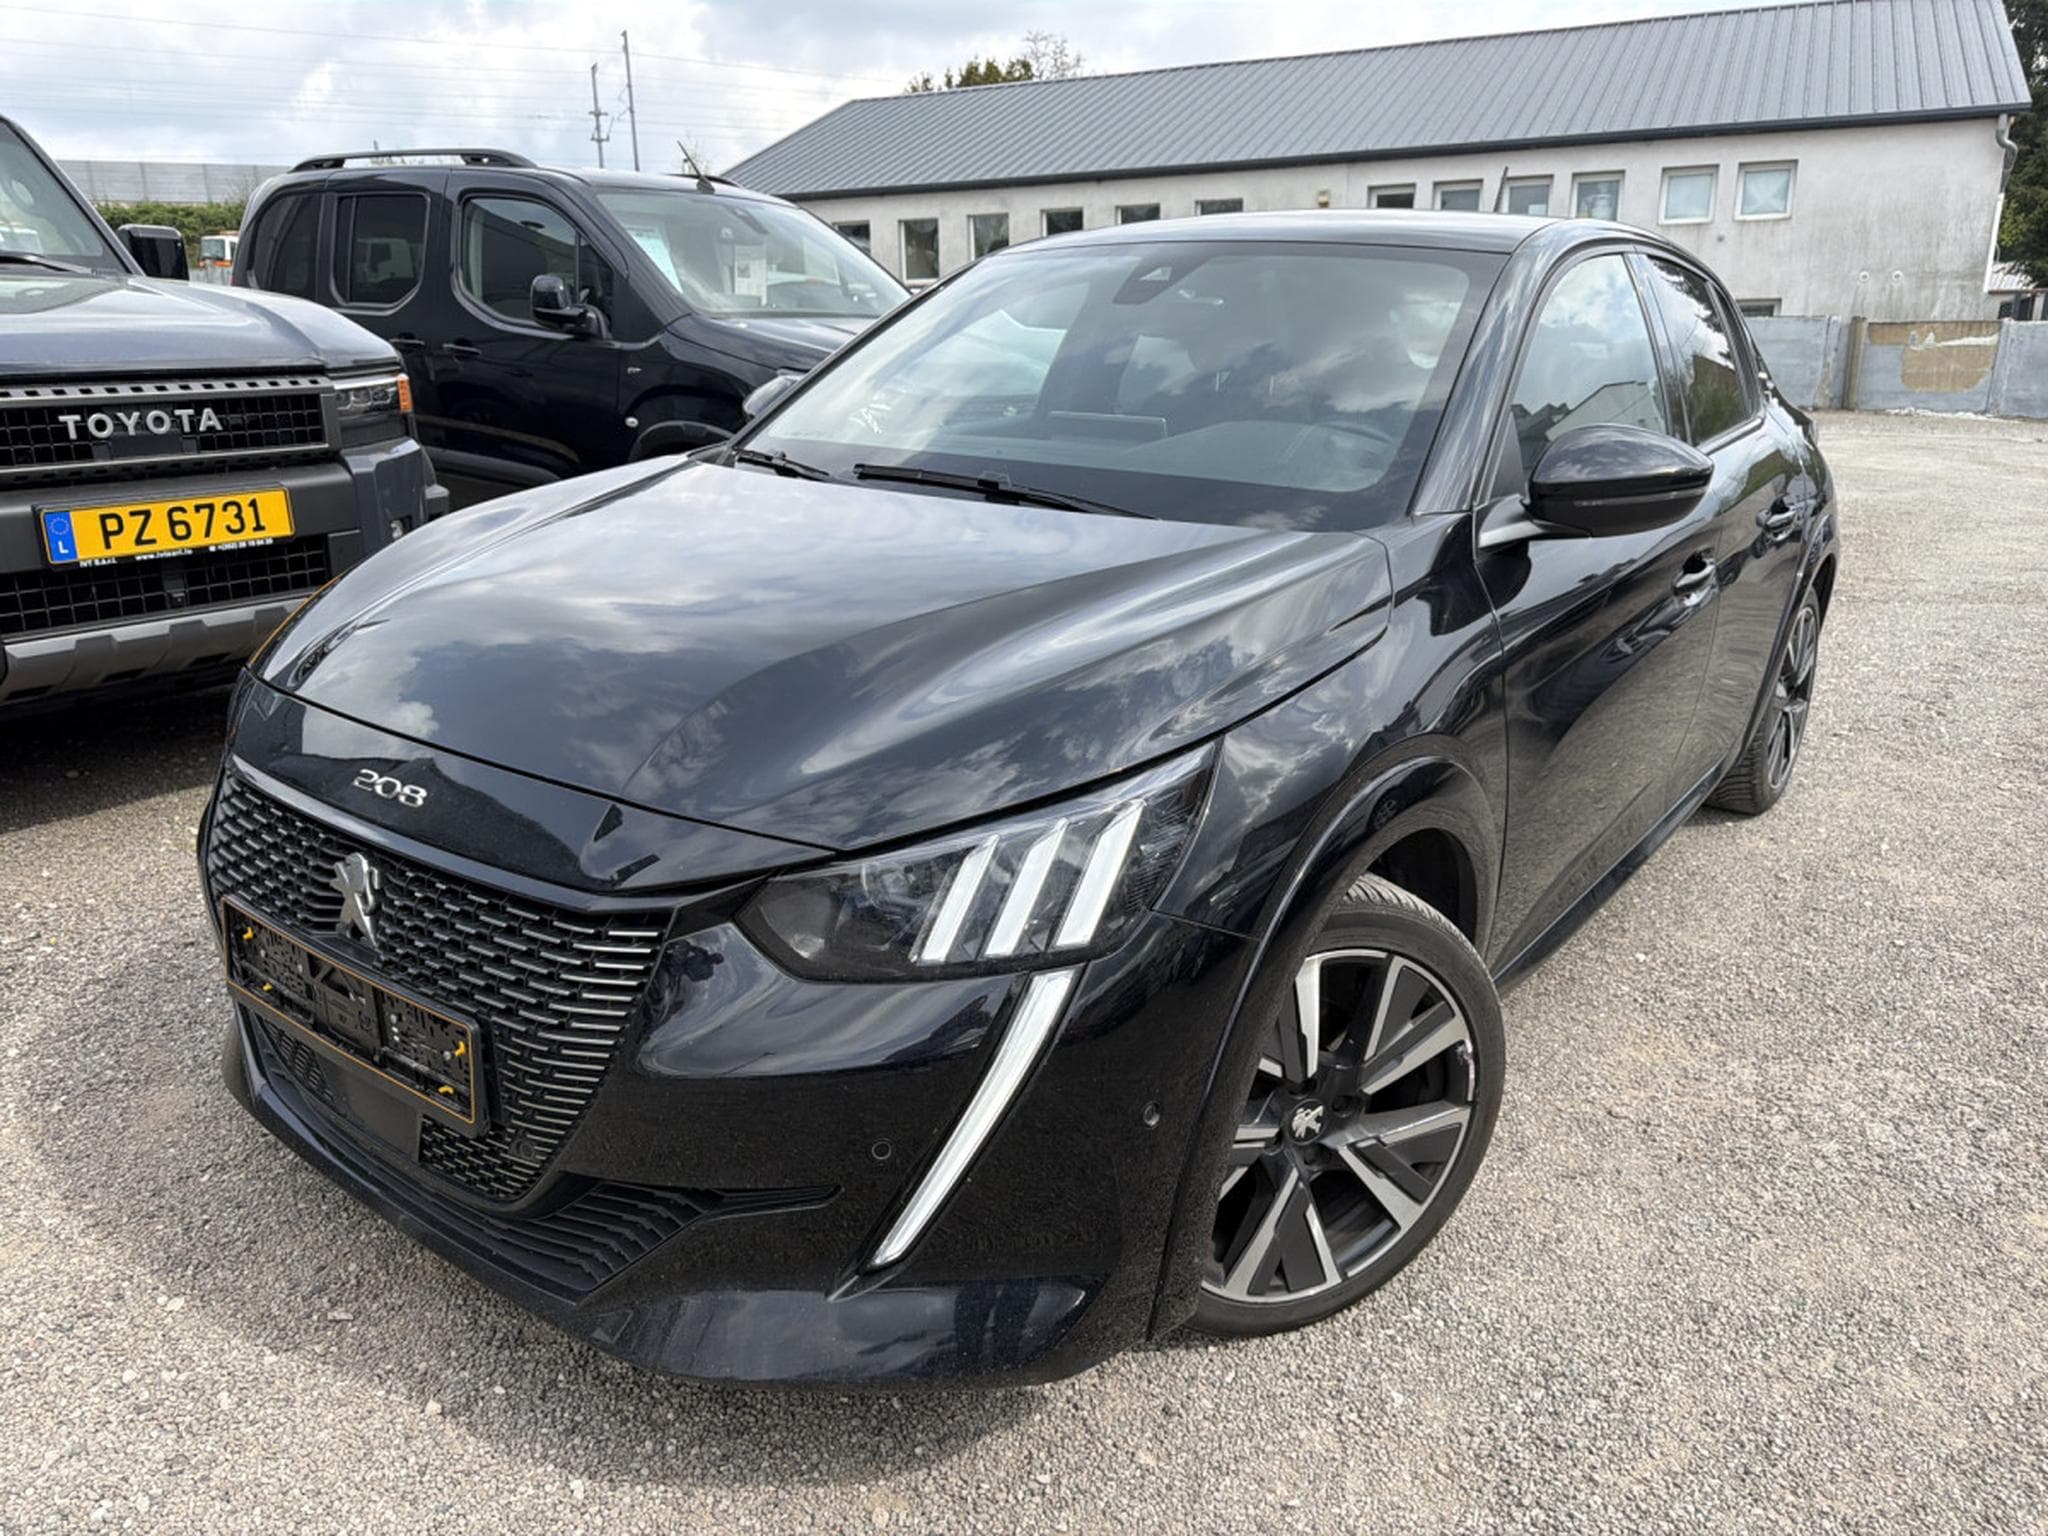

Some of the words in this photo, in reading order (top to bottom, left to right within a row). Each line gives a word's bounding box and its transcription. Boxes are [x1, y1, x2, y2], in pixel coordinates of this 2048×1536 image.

[58, 407, 223, 440] TOYOTA
[98, 508, 158, 549] PZ
[166, 498, 266, 541] 6731
[58, 541, 70, 554] L
[353, 768, 428, 808] 208
